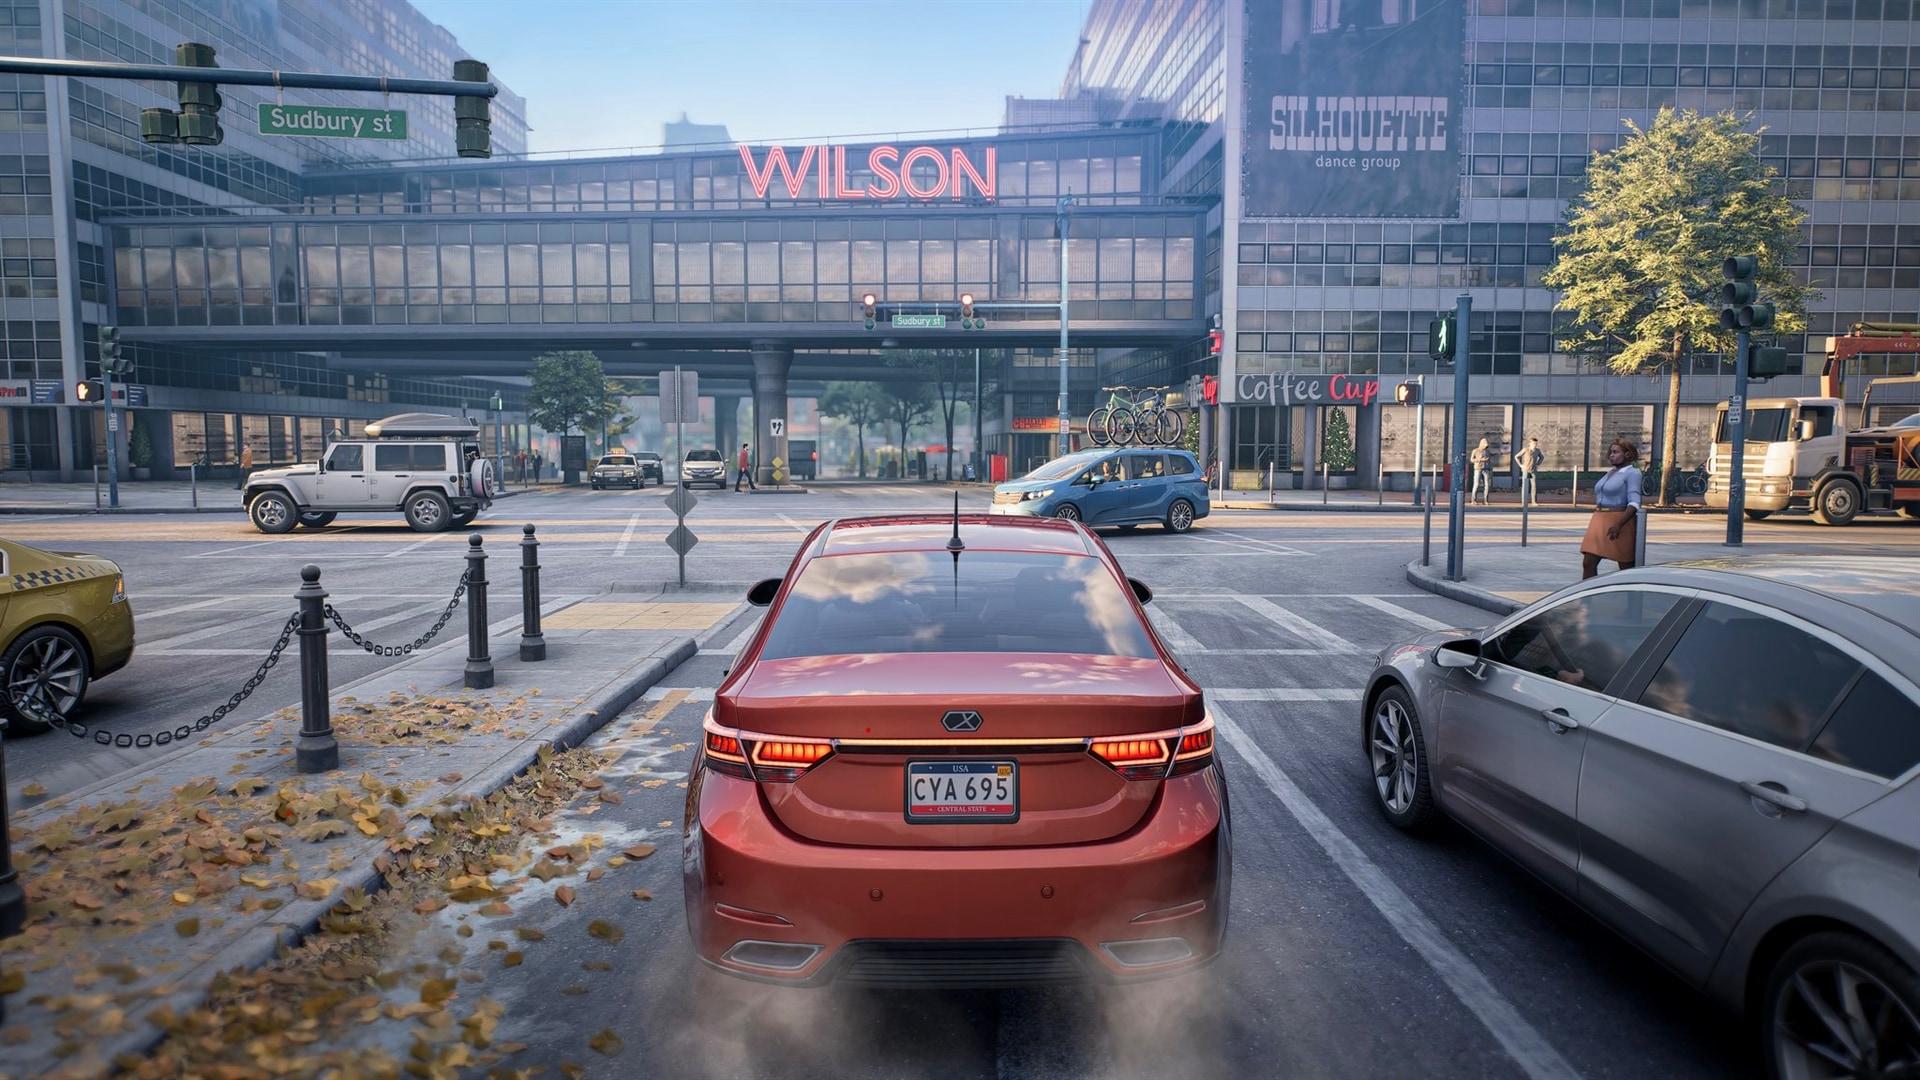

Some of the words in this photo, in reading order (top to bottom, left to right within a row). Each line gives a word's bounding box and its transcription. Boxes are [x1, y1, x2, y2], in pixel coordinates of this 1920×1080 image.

[271, 108, 365, 137] Sudbury
[373, 114, 393, 133] st
[1269, 95, 1448, 151] SILHOUETTE
[737, 144, 997, 201] WILSON
[1315, 155, 1356, 168] dance
[1361, 157, 1401, 171] group
[897, 316, 931, 327] Sudbury
[932, 317, 941, 325] st
[1238, 370, 1322, 406] Coffee
[1329, 373, 1380, 407] Cup
[952, 765, 969, 773] USA
[914, 777, 957, 801] CYA
[965, 777, 1008, 801] 695
